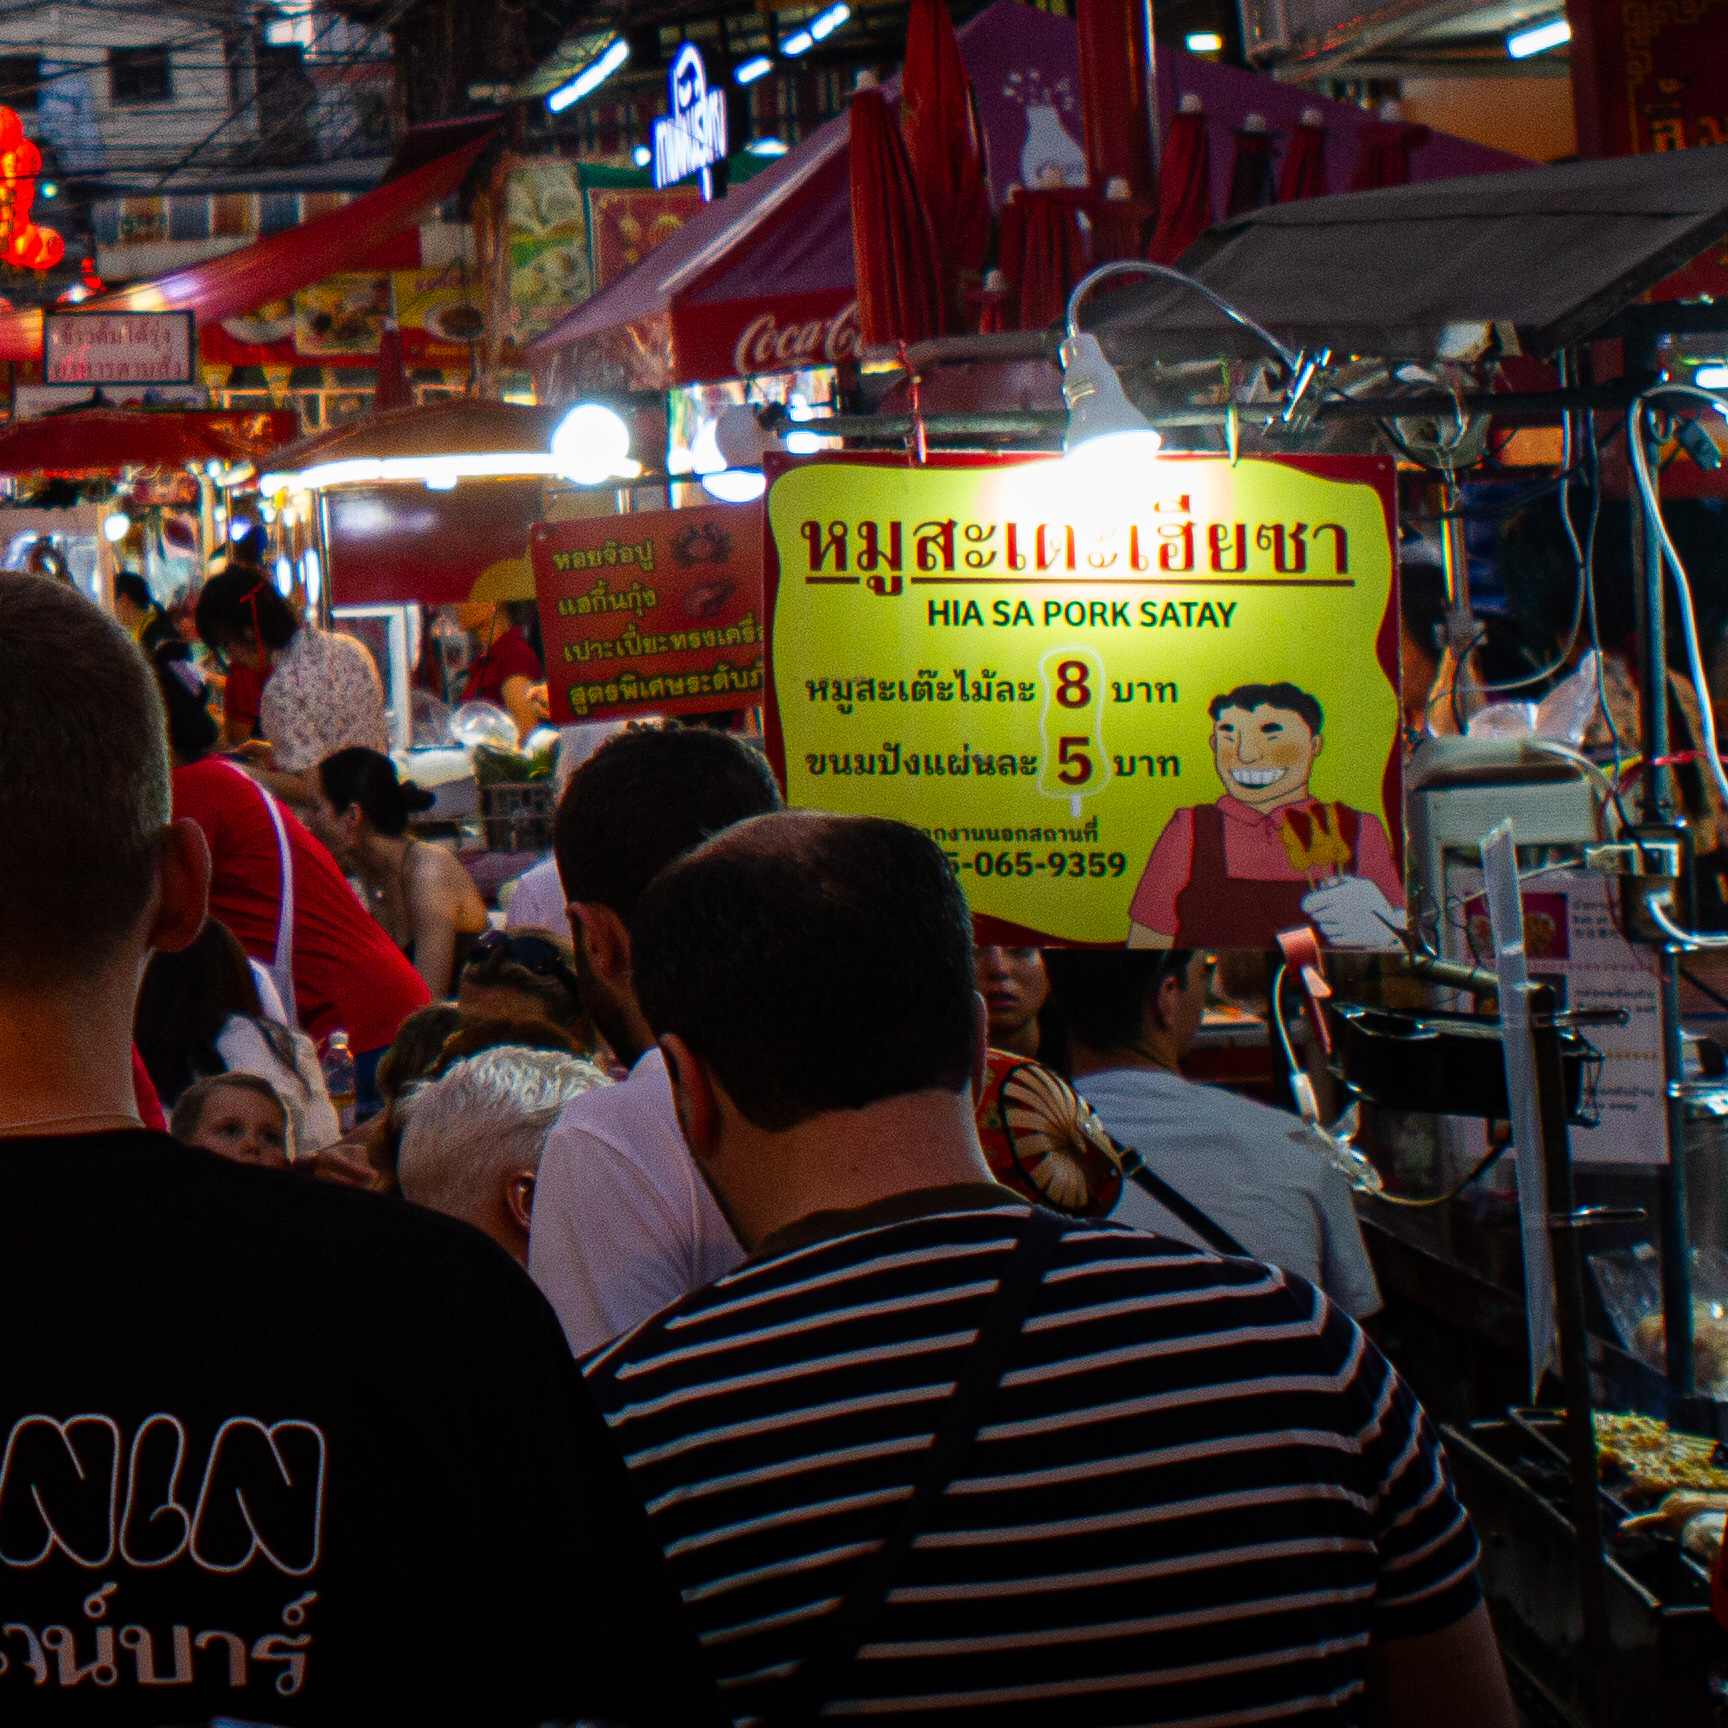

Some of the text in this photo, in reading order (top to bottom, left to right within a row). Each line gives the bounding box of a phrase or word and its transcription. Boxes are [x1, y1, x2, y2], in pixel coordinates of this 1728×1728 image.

[927, 599, 1239, 628] HIA SA PORK SATAY
[805, 659, 1180, 715] หมูสะเต๊ะไม้ละ 8 บาท
[805, 735, 1182, 786] ขนมปังแผ่นละ 5 บาท
[946, 851, 1128, 878] 5-065-9359
